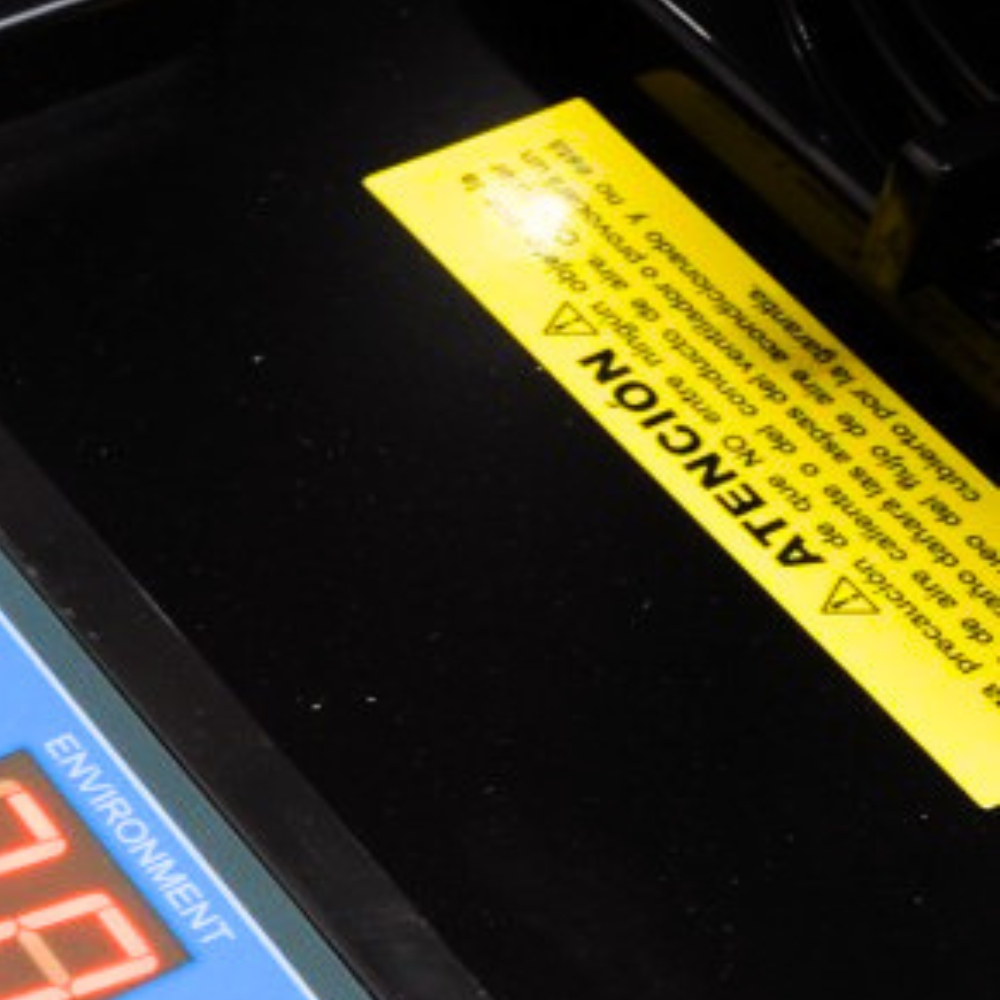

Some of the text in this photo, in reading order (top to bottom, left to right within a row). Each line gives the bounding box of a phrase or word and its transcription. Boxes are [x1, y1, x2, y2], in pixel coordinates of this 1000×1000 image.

[625, 212, 650, 225] y
[630, 297, 661, 323] de
[654, 283, 755, 373] ventilador
[662, 328, 760, 418] conducto
[746, 373, 789, 405] del
[665, 375, 722, 425] entre
[849, 388, 899, 421] por
[755, 424, 798, 455] del
[835, 411, 868, 438] de
[578, 348, 826, 567] ATENCIÓN
[721, 434, 763, 468] NO
[890, 422, 982, 503] cubierto
[767, 474, 812, 513] que
[848, 465, 885, 499] las
[822, 484, 908, 562] caliente
[917, 495, 963, 527] del
[816, 521, 849, 549] de
[910, 569, 959, 609] aire
[852, 556, 984, 675] precaución
[960, 617, 994, 645] de
[44, 733, 235, 946] ENVIRONMENT
